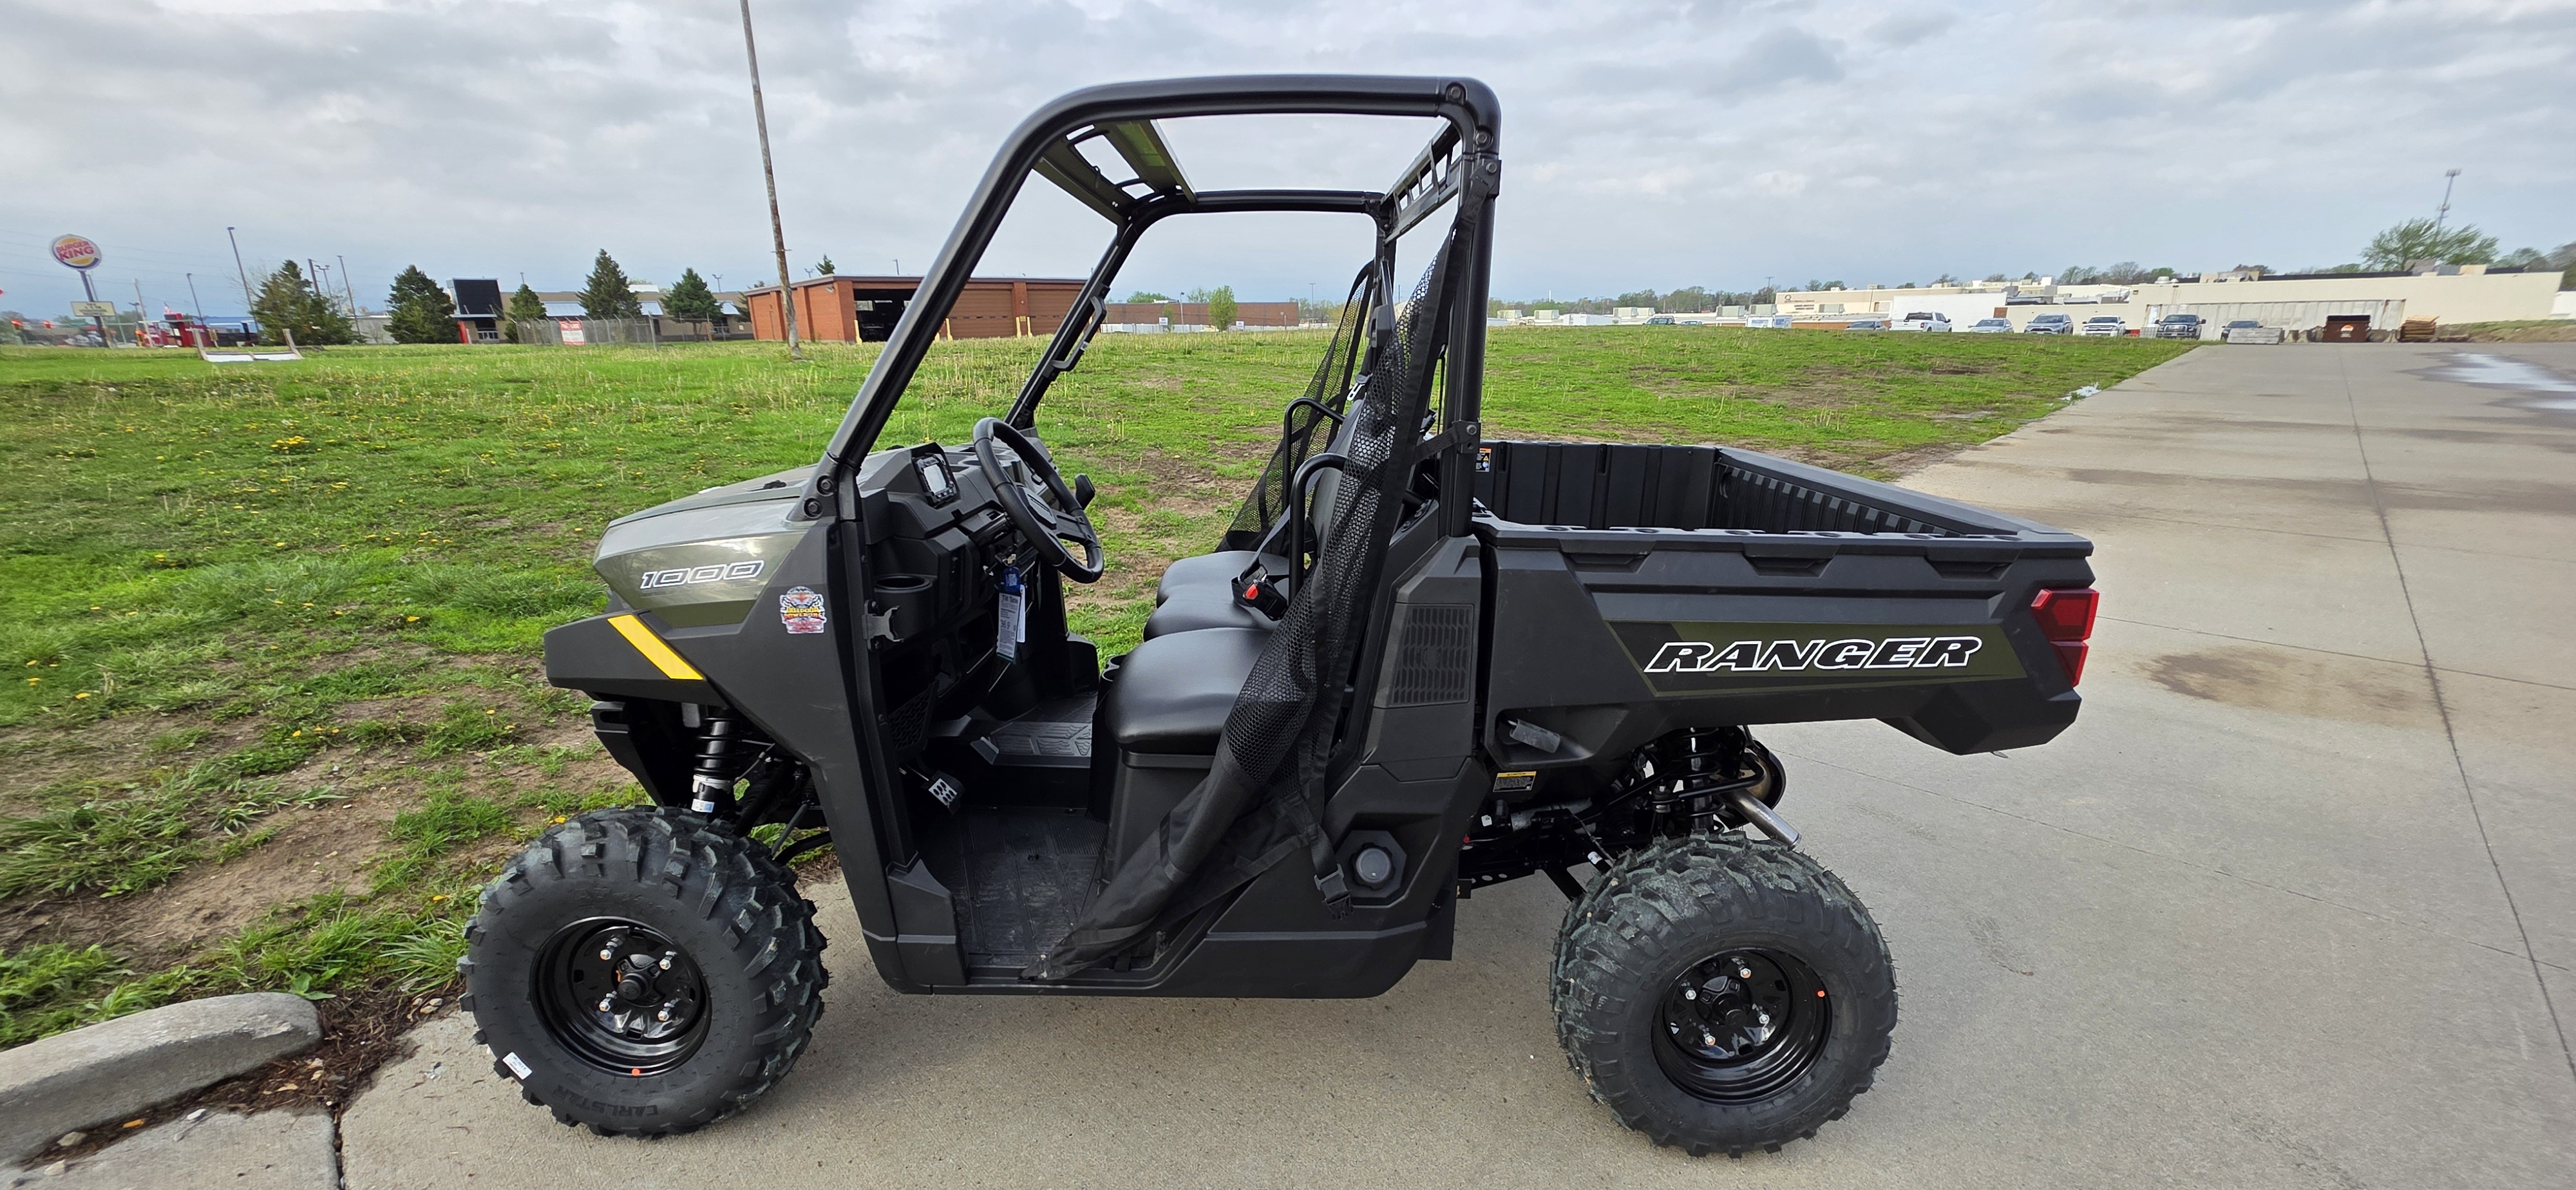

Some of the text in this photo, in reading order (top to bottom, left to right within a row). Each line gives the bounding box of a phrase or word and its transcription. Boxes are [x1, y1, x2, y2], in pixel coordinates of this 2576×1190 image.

[56, 241, 90, 253] BURGER
[59, 247, 94, 261] KING
[640, 560, 764, 589] 1000
[1644, 636, 1982, 673] RANGER
[553, 1084, 659, 1117] CARLSTAR
